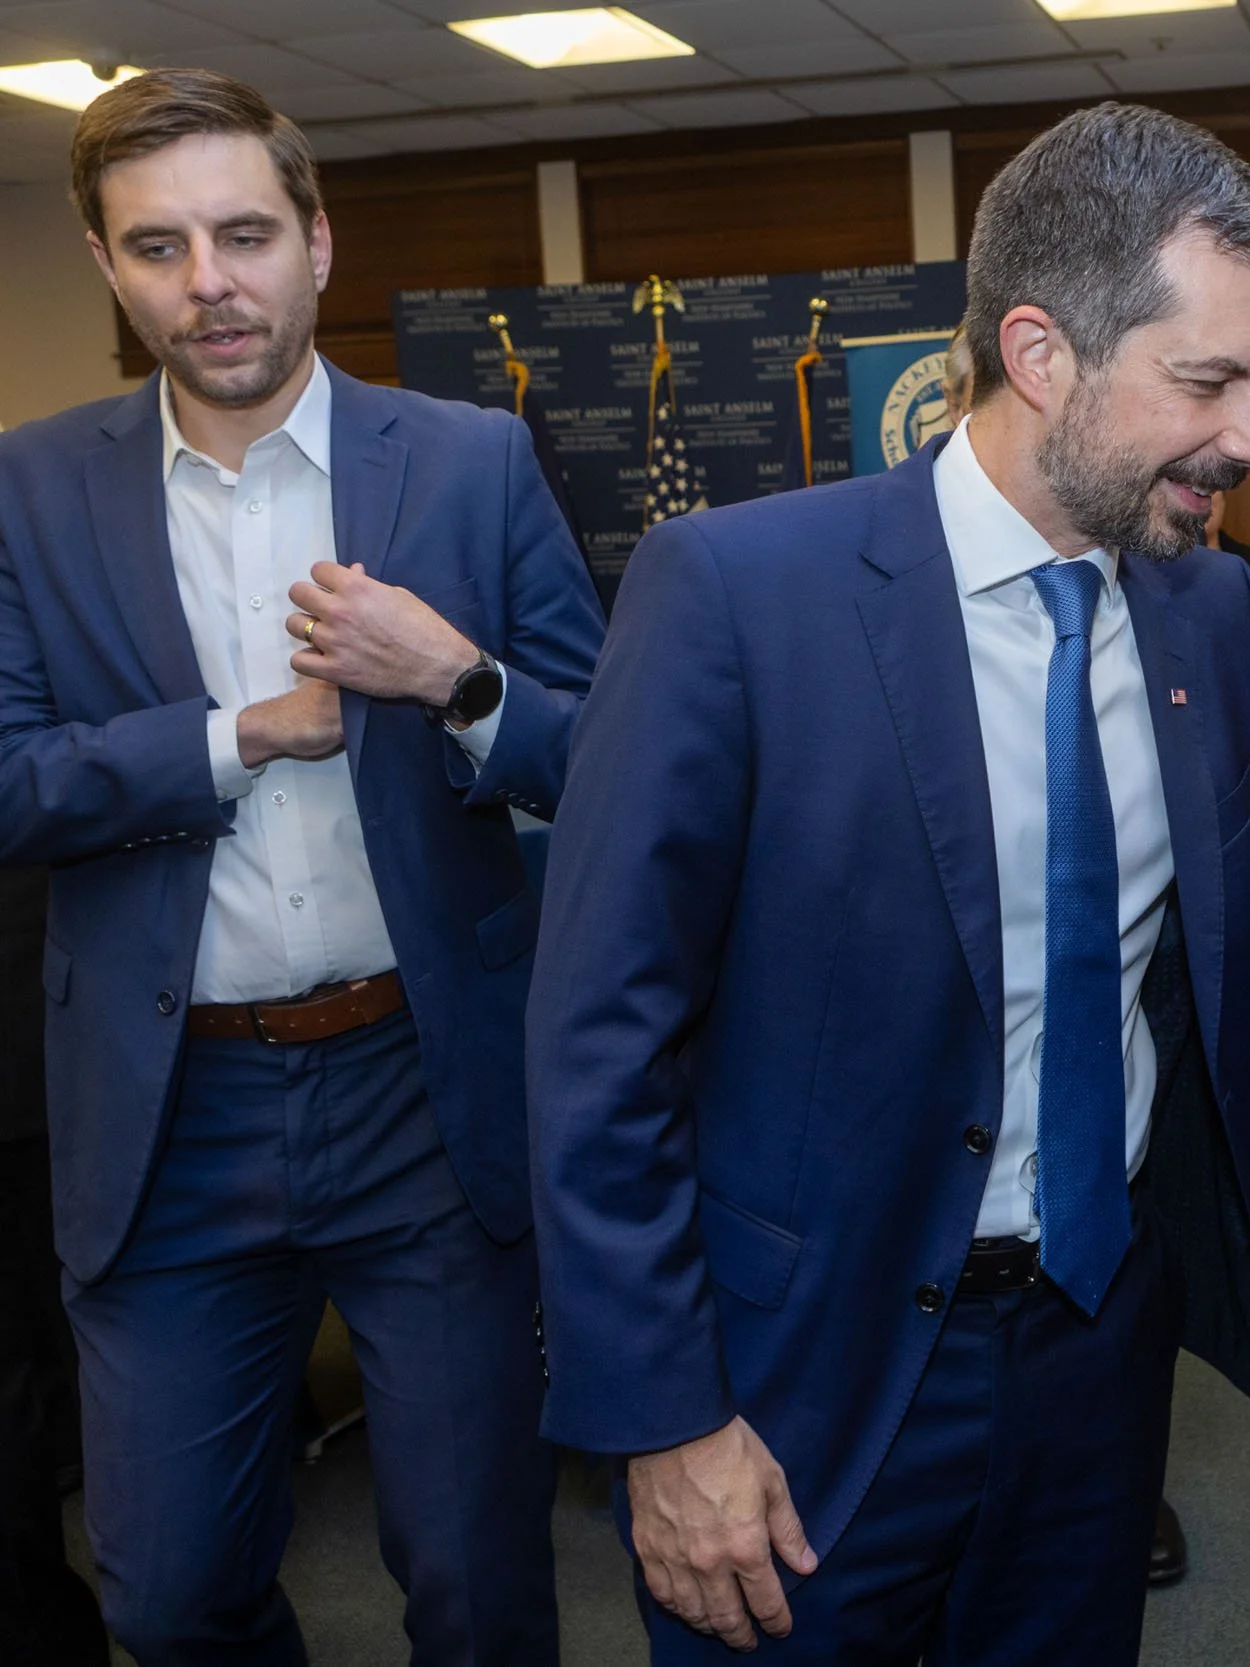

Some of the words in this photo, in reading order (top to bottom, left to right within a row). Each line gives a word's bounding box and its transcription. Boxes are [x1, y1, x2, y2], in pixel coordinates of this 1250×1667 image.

[752, 334, 789, 349] SAINT
[793, 332, 843, 346] ANELM
[610, 342, 647, 356] SAINT
[683, 402, 721, 416] SAINT
[724, 400, 774, 414] ANSELM
